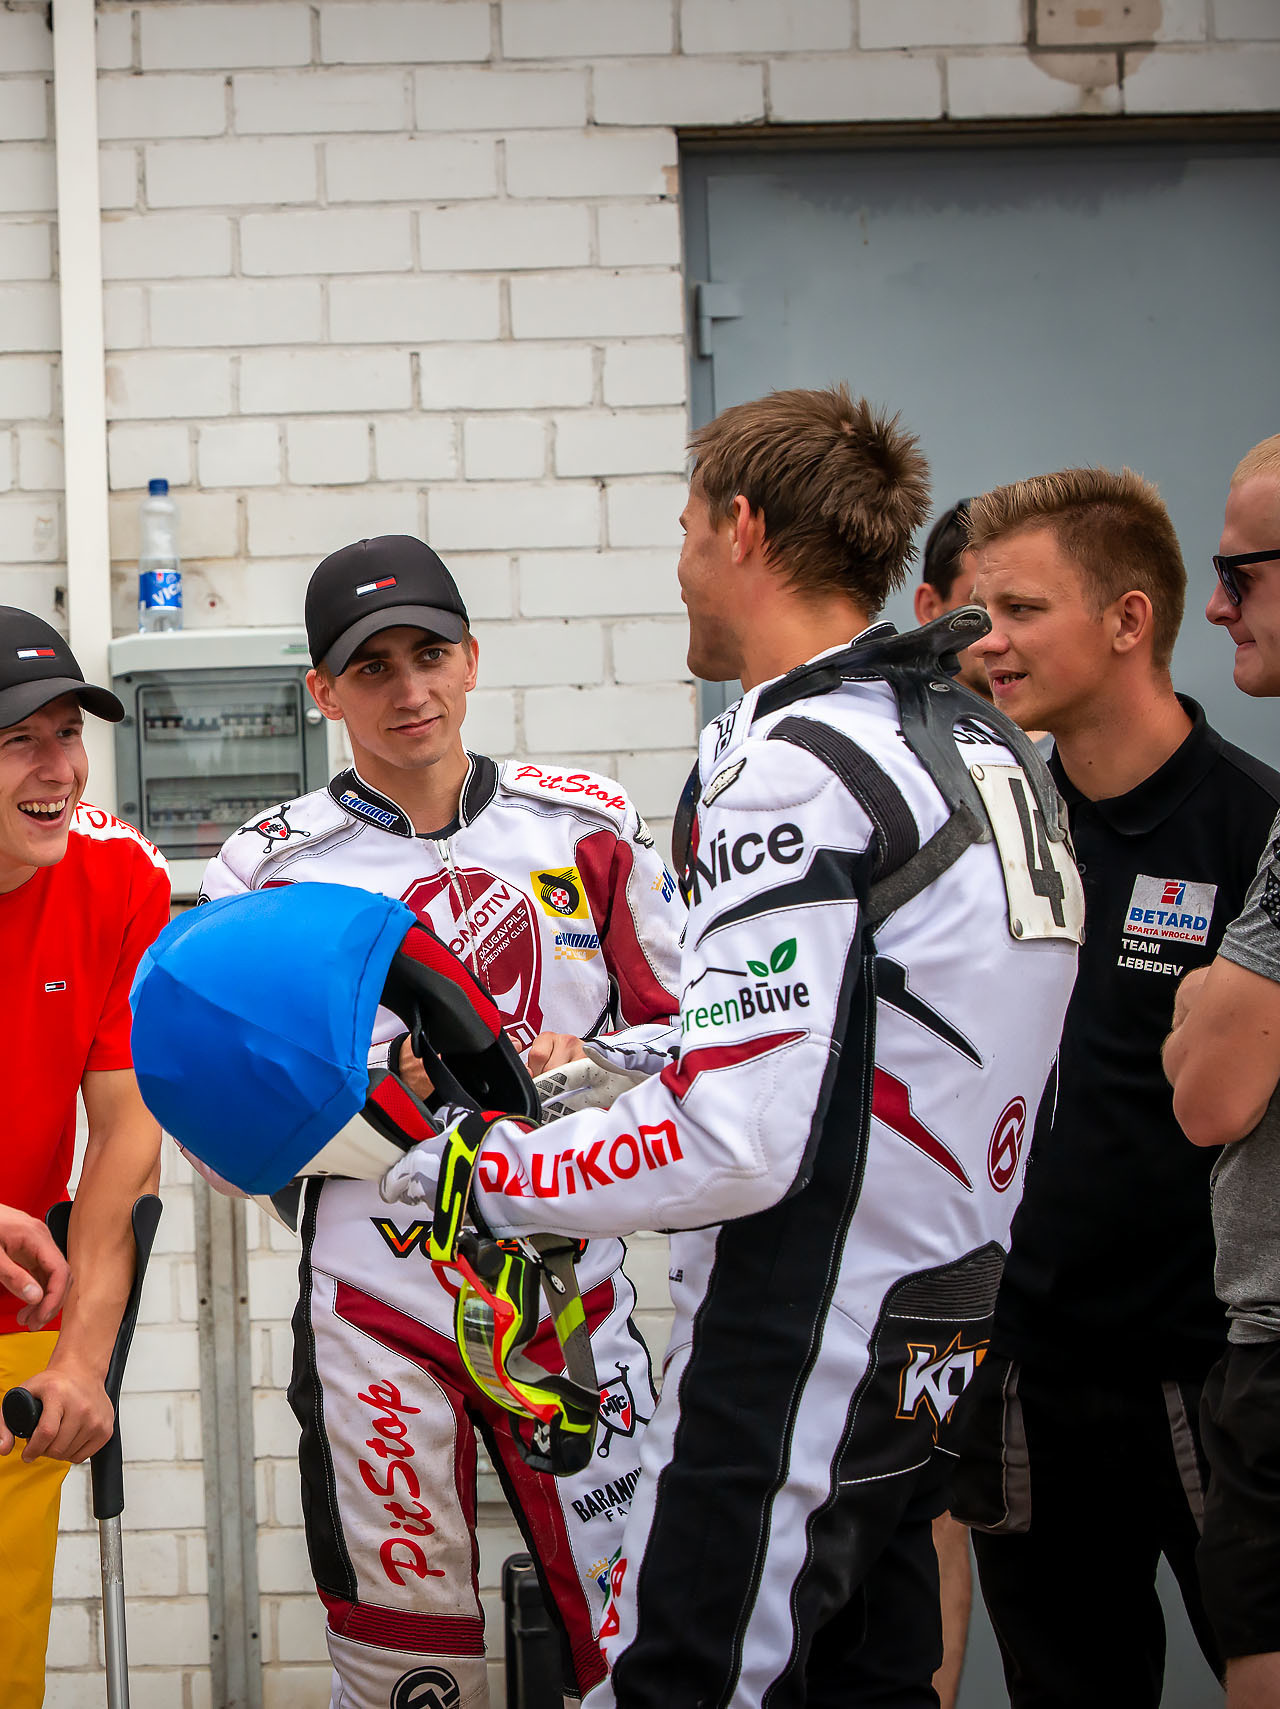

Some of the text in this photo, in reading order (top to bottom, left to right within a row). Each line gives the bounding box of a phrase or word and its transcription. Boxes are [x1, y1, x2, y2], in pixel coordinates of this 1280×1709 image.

[515, 766, 626, 811] PitStop
[1008, 777, 1066, 928] 4
[510, 920, 529, 939] CLUB
[1126, 924, 1159, 936] SPARTA
[1129, 907, 1208, 931] BETARD
[1121, 938, 1161, 955] TEAM
[1116, 955, 1184, 977] LEBEDEV
[600, 1394, 628, 1417] MTC
[357, 1379, 446, 1587] PitStop
